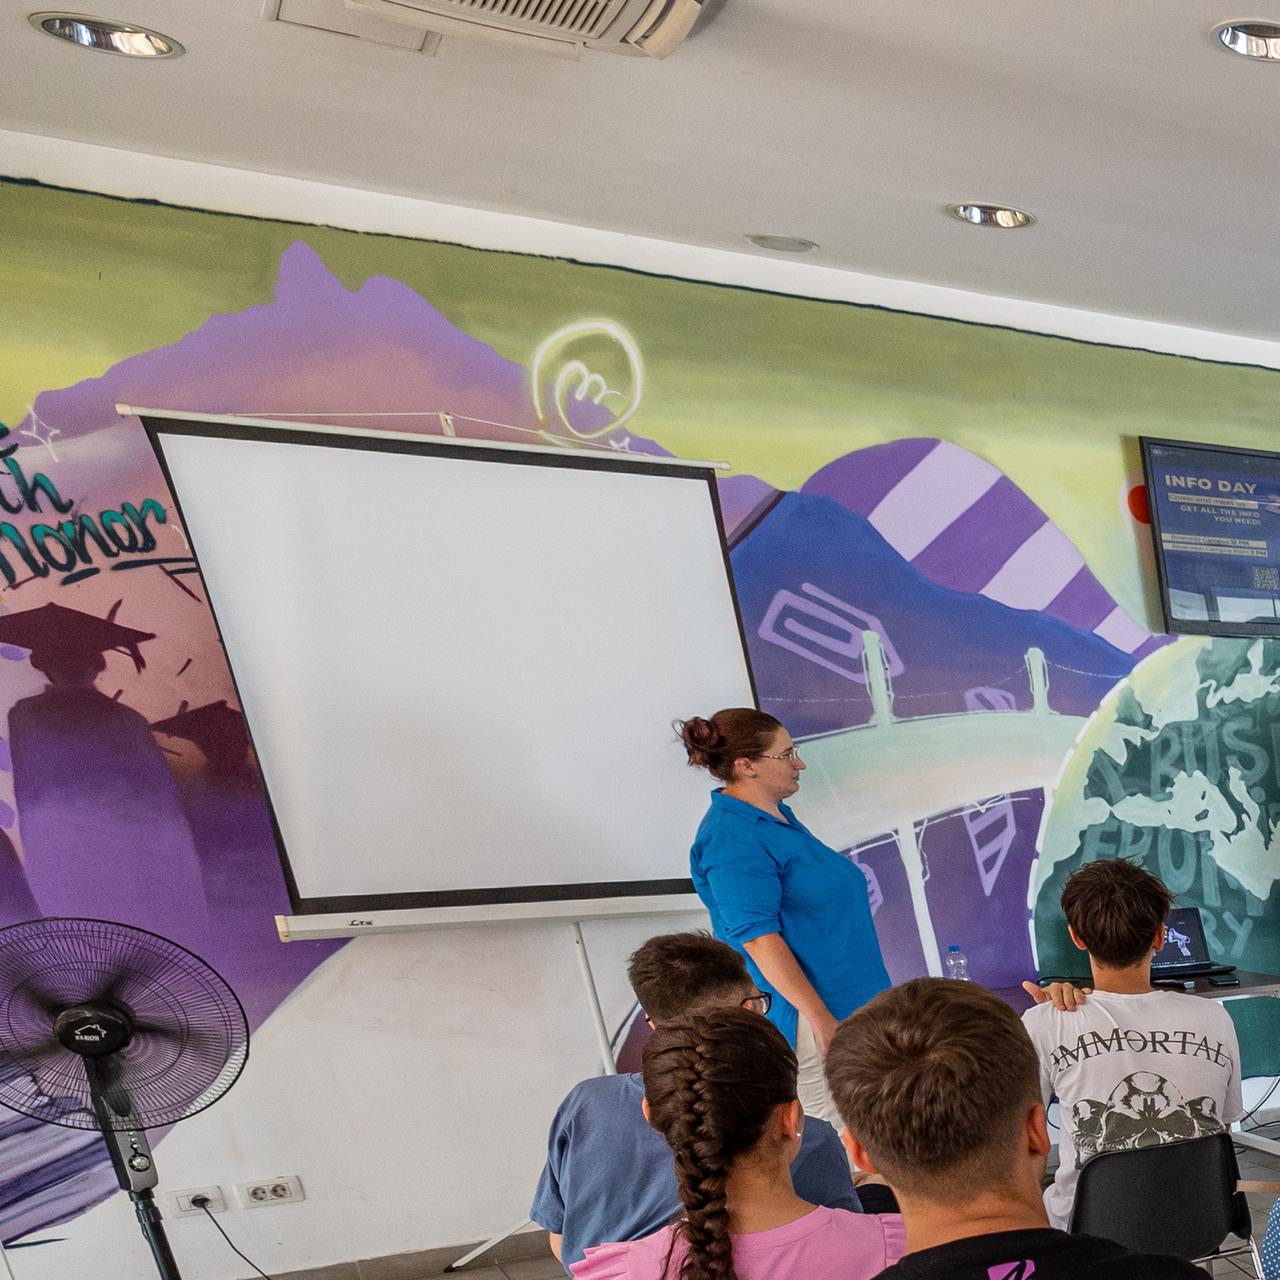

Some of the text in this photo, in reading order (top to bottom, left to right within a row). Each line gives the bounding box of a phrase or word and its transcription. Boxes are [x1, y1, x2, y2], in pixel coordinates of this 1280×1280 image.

[1165, 474, 1257, 494] INFO DAY
[1200, 506, 1216, 514] ALL
[1219, 508, 1236, 517] THE
[1238, 510, 1260, 518] INFO
[1214, 515, 1232, 523] YOU
[1050, 1027, 1232, 1072] IMMORTAL
